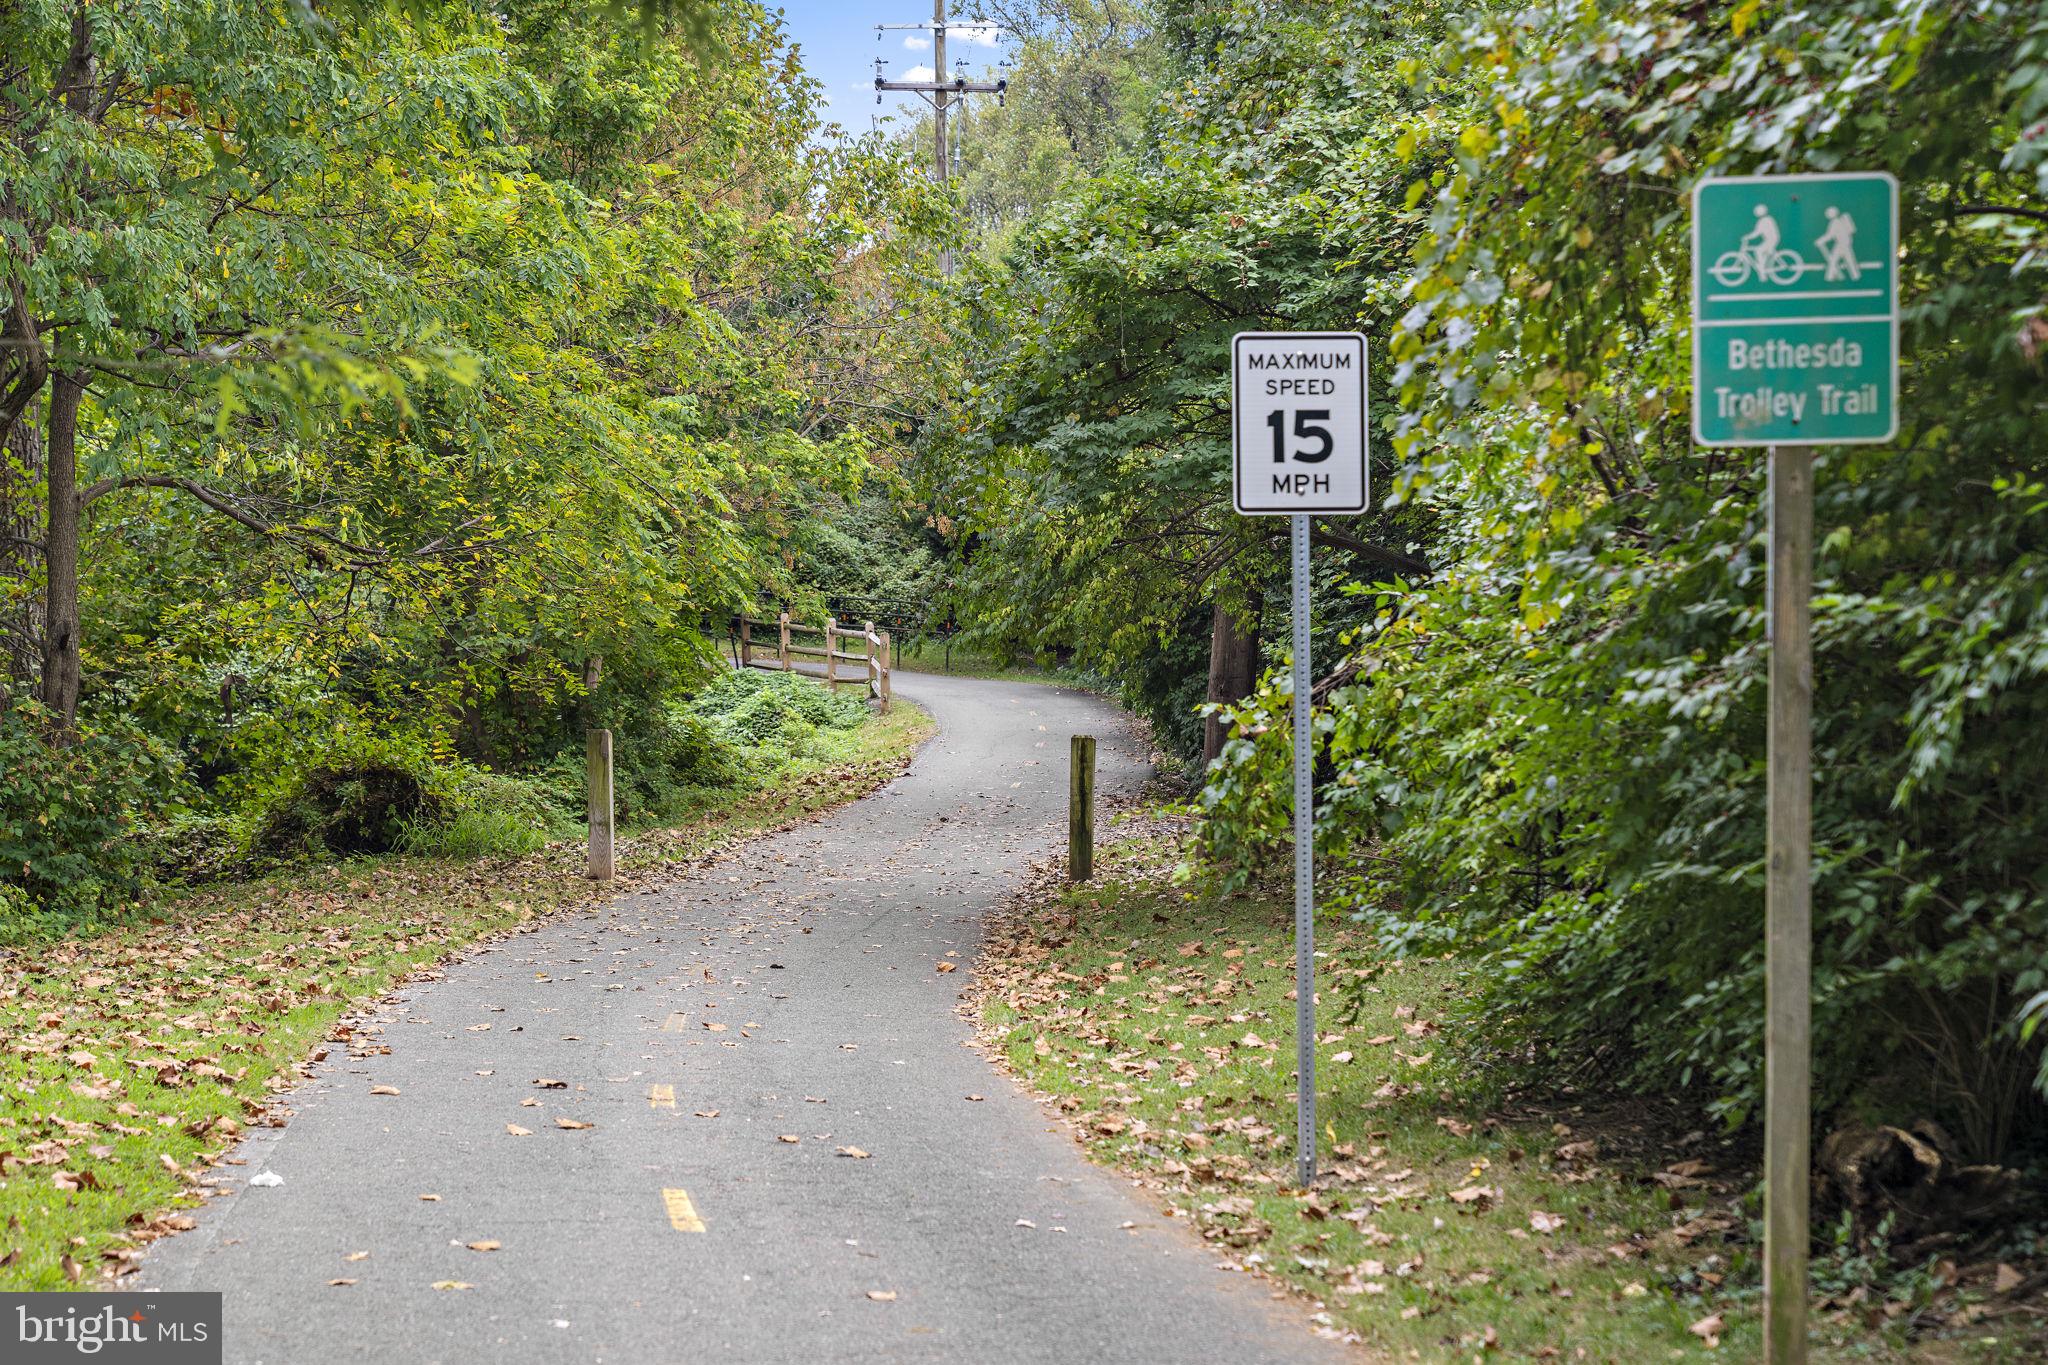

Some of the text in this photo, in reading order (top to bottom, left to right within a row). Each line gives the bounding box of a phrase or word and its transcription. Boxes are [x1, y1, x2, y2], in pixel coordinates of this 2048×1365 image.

[1248, 353, 1351, 370] MAXIMUM
[1727, 337, 1863, 371] Bethesda
[1265, 379, 1336, 395] SPEED
[1713, 383, 1879, 423] Trolley Trail
[1266, 409, 1334, 464] 15
[1272, 474, 1330, 494] MPH
